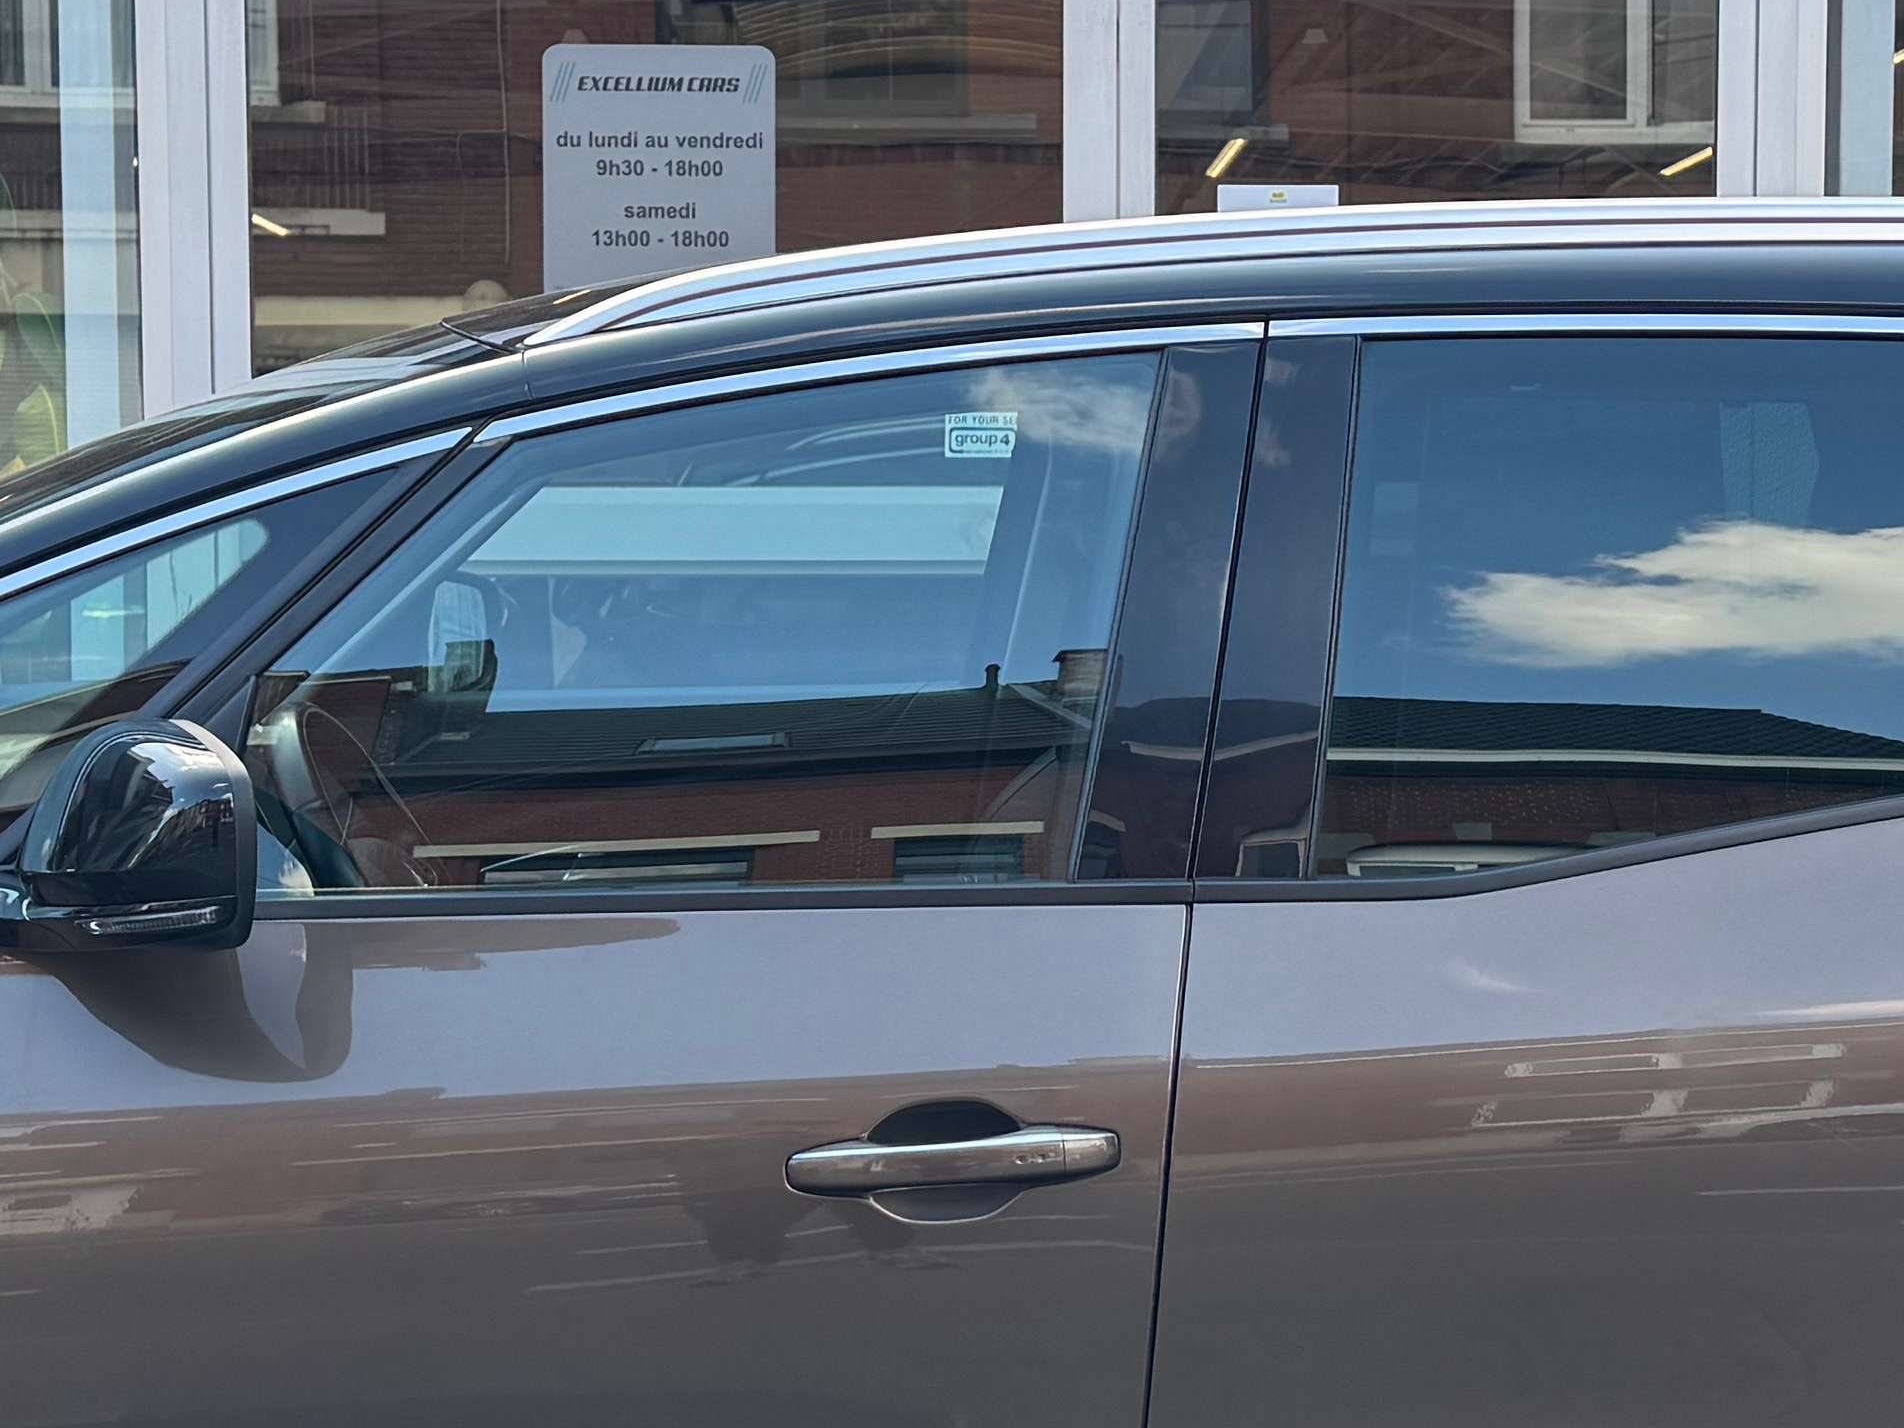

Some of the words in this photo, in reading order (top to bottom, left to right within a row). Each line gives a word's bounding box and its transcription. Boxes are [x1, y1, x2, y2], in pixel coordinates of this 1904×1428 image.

[577, 75, 684, 93] EXCELLIUM
[687, 76, 741, 93] CARS
[556, 131, 582, 149] du
[588, 131, 639, 149] lundi
[645, 135, 669, 149] au
[676, 131, 764, 149] vendredi
[596, 159, 645, 177] 9h30
[664, 160, 723, 177] 18h00
[624, 202, 697, 220] samedi
[592, 229, 650, 248] 13h00
[671, 230, 730, 248] 18h00
[955, 433, 998, 447] group
[1000, 433, 1011, 447] 4
